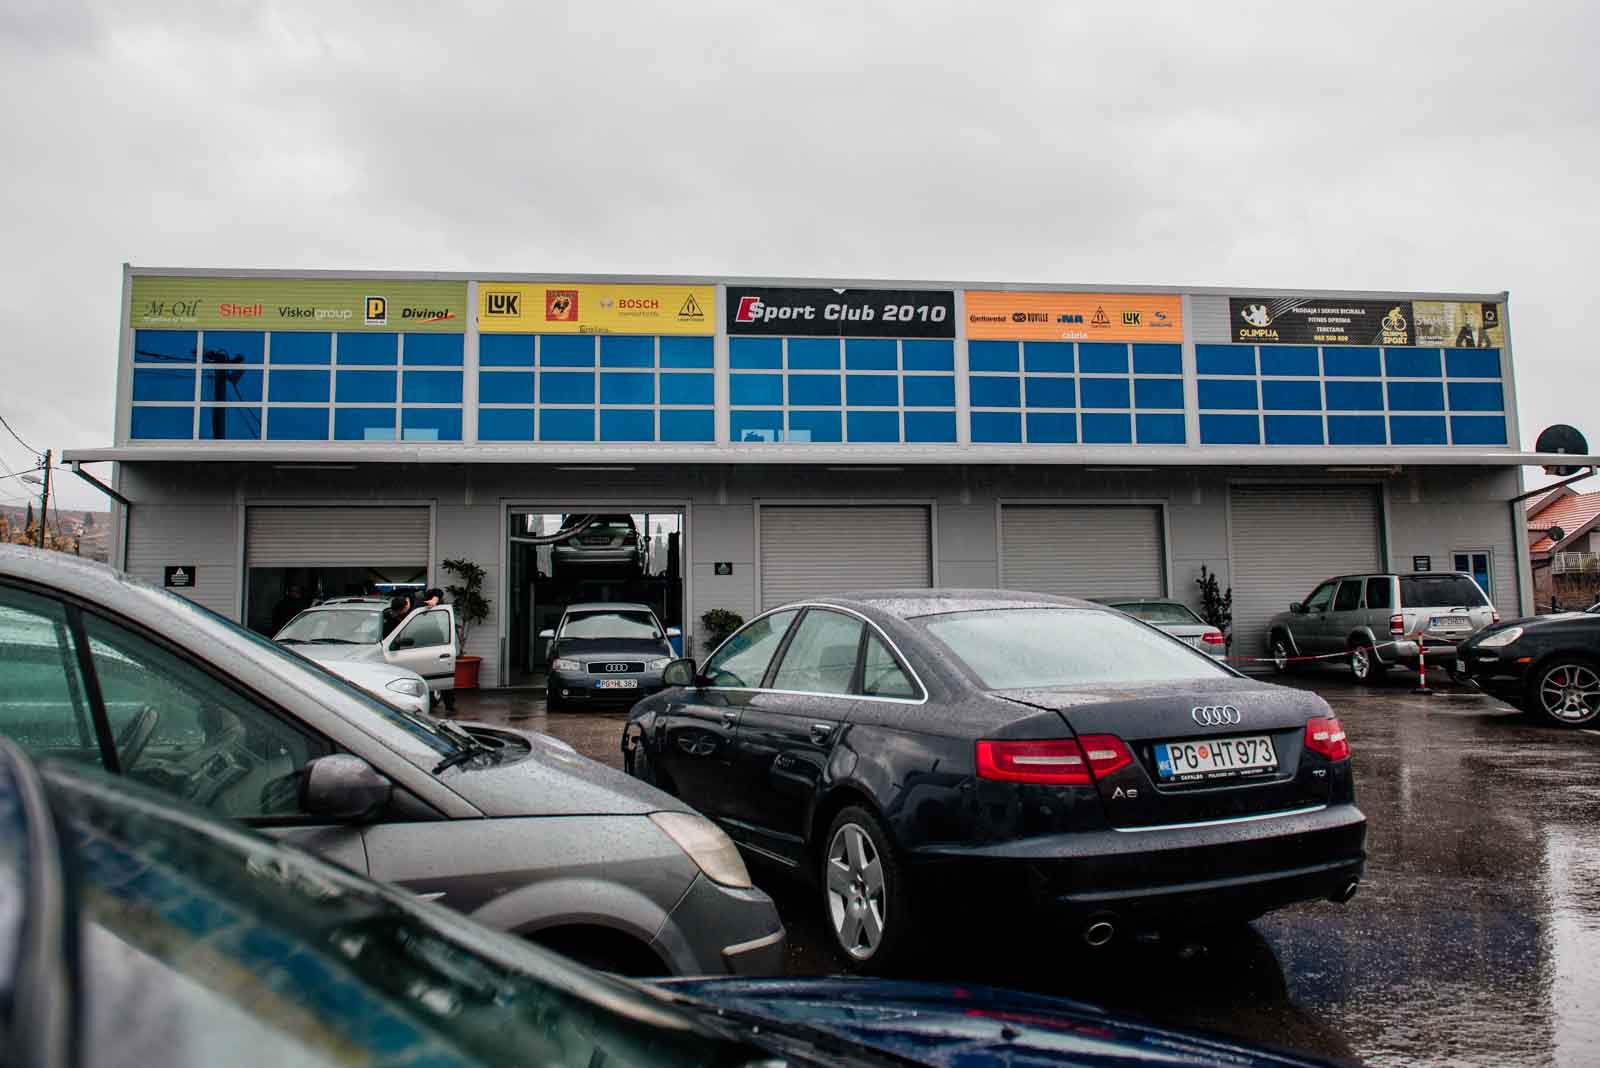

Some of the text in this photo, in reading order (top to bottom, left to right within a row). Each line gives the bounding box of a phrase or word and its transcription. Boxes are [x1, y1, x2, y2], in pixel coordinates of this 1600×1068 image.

[219, 303, 263, 318] Shell
[618, 298, 659, 310] BOSCH
[401, 307, 449, 320] Divinol
[748, 302, 947, 323] Sport Club 2010
[1240, 328, 1279, 338] OLIMPIJA
[1383, 336, 1408, 345] SPORT
[1171, 745, 1199, 771] PG
